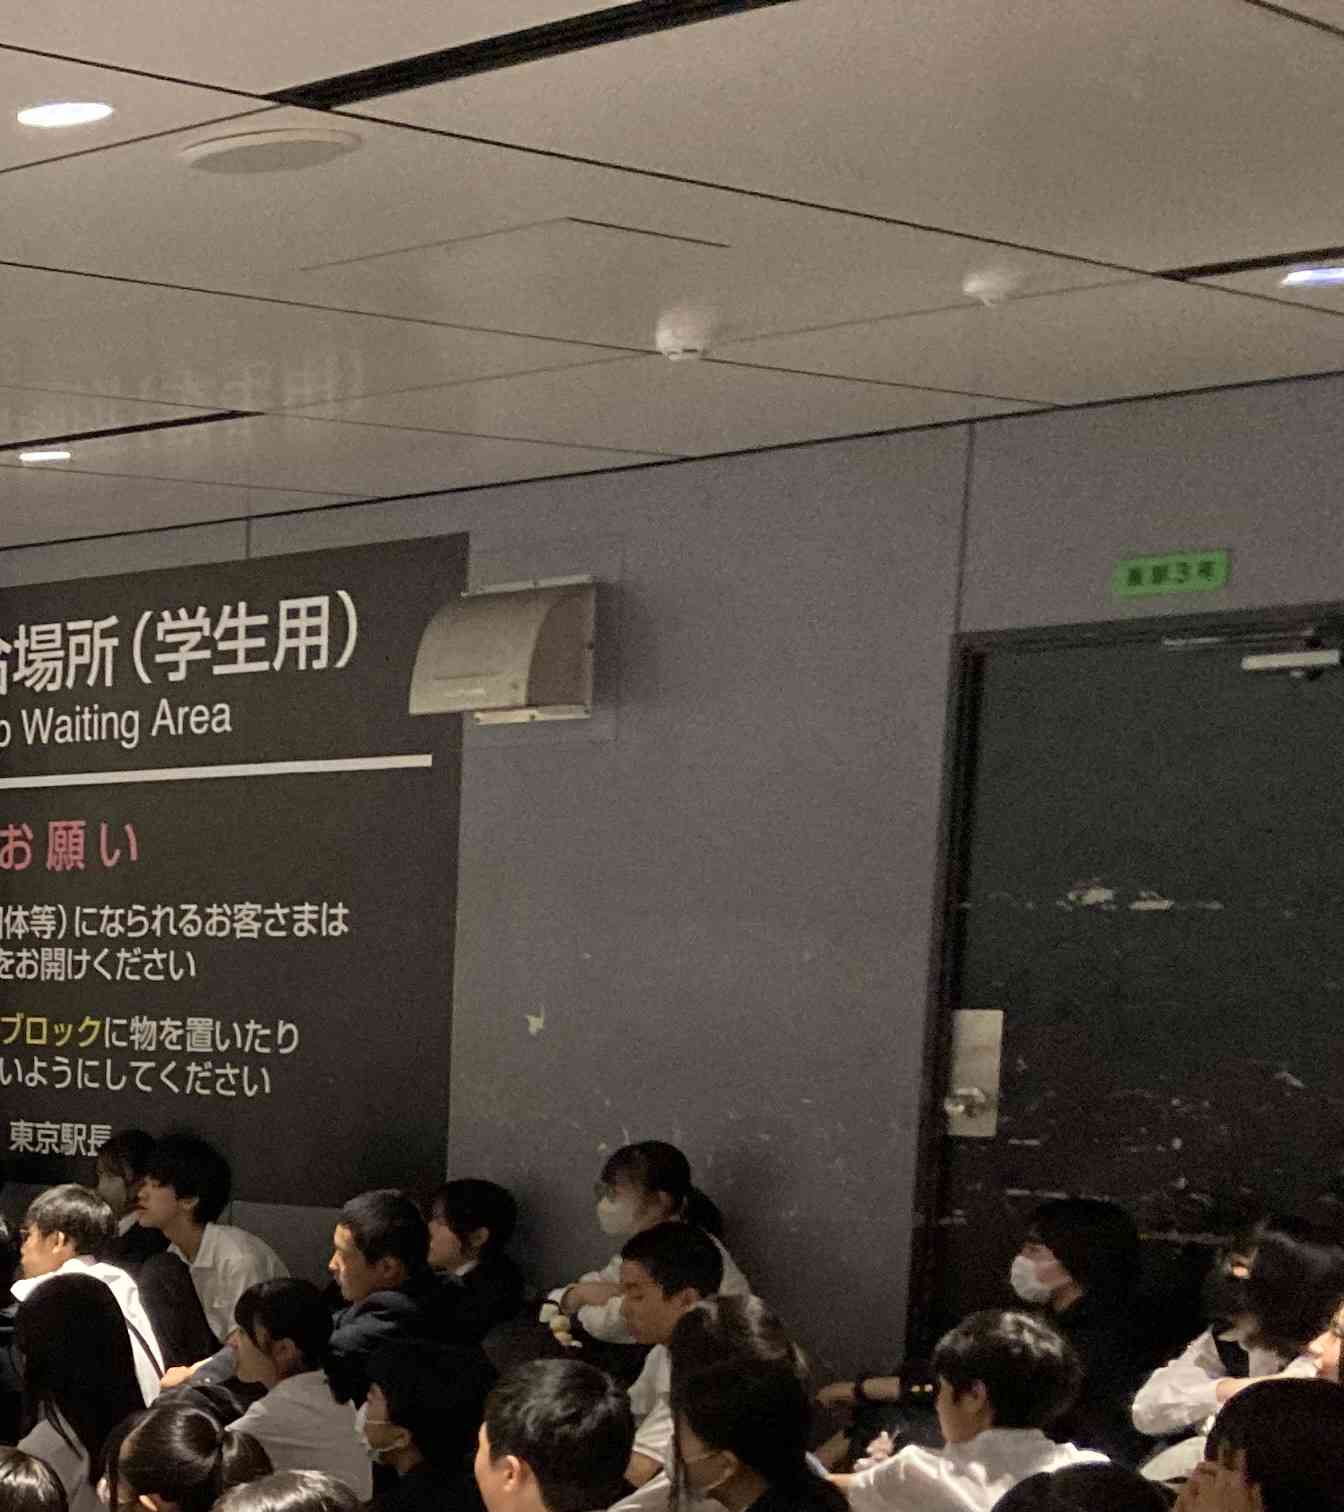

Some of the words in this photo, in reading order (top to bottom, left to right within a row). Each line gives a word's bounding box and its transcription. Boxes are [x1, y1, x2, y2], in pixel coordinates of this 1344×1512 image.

[21, 702, 140, 749] Waiting
[151, 697, 232, 737] Area
[9, 1118, 112, 1158] 東京駅長
